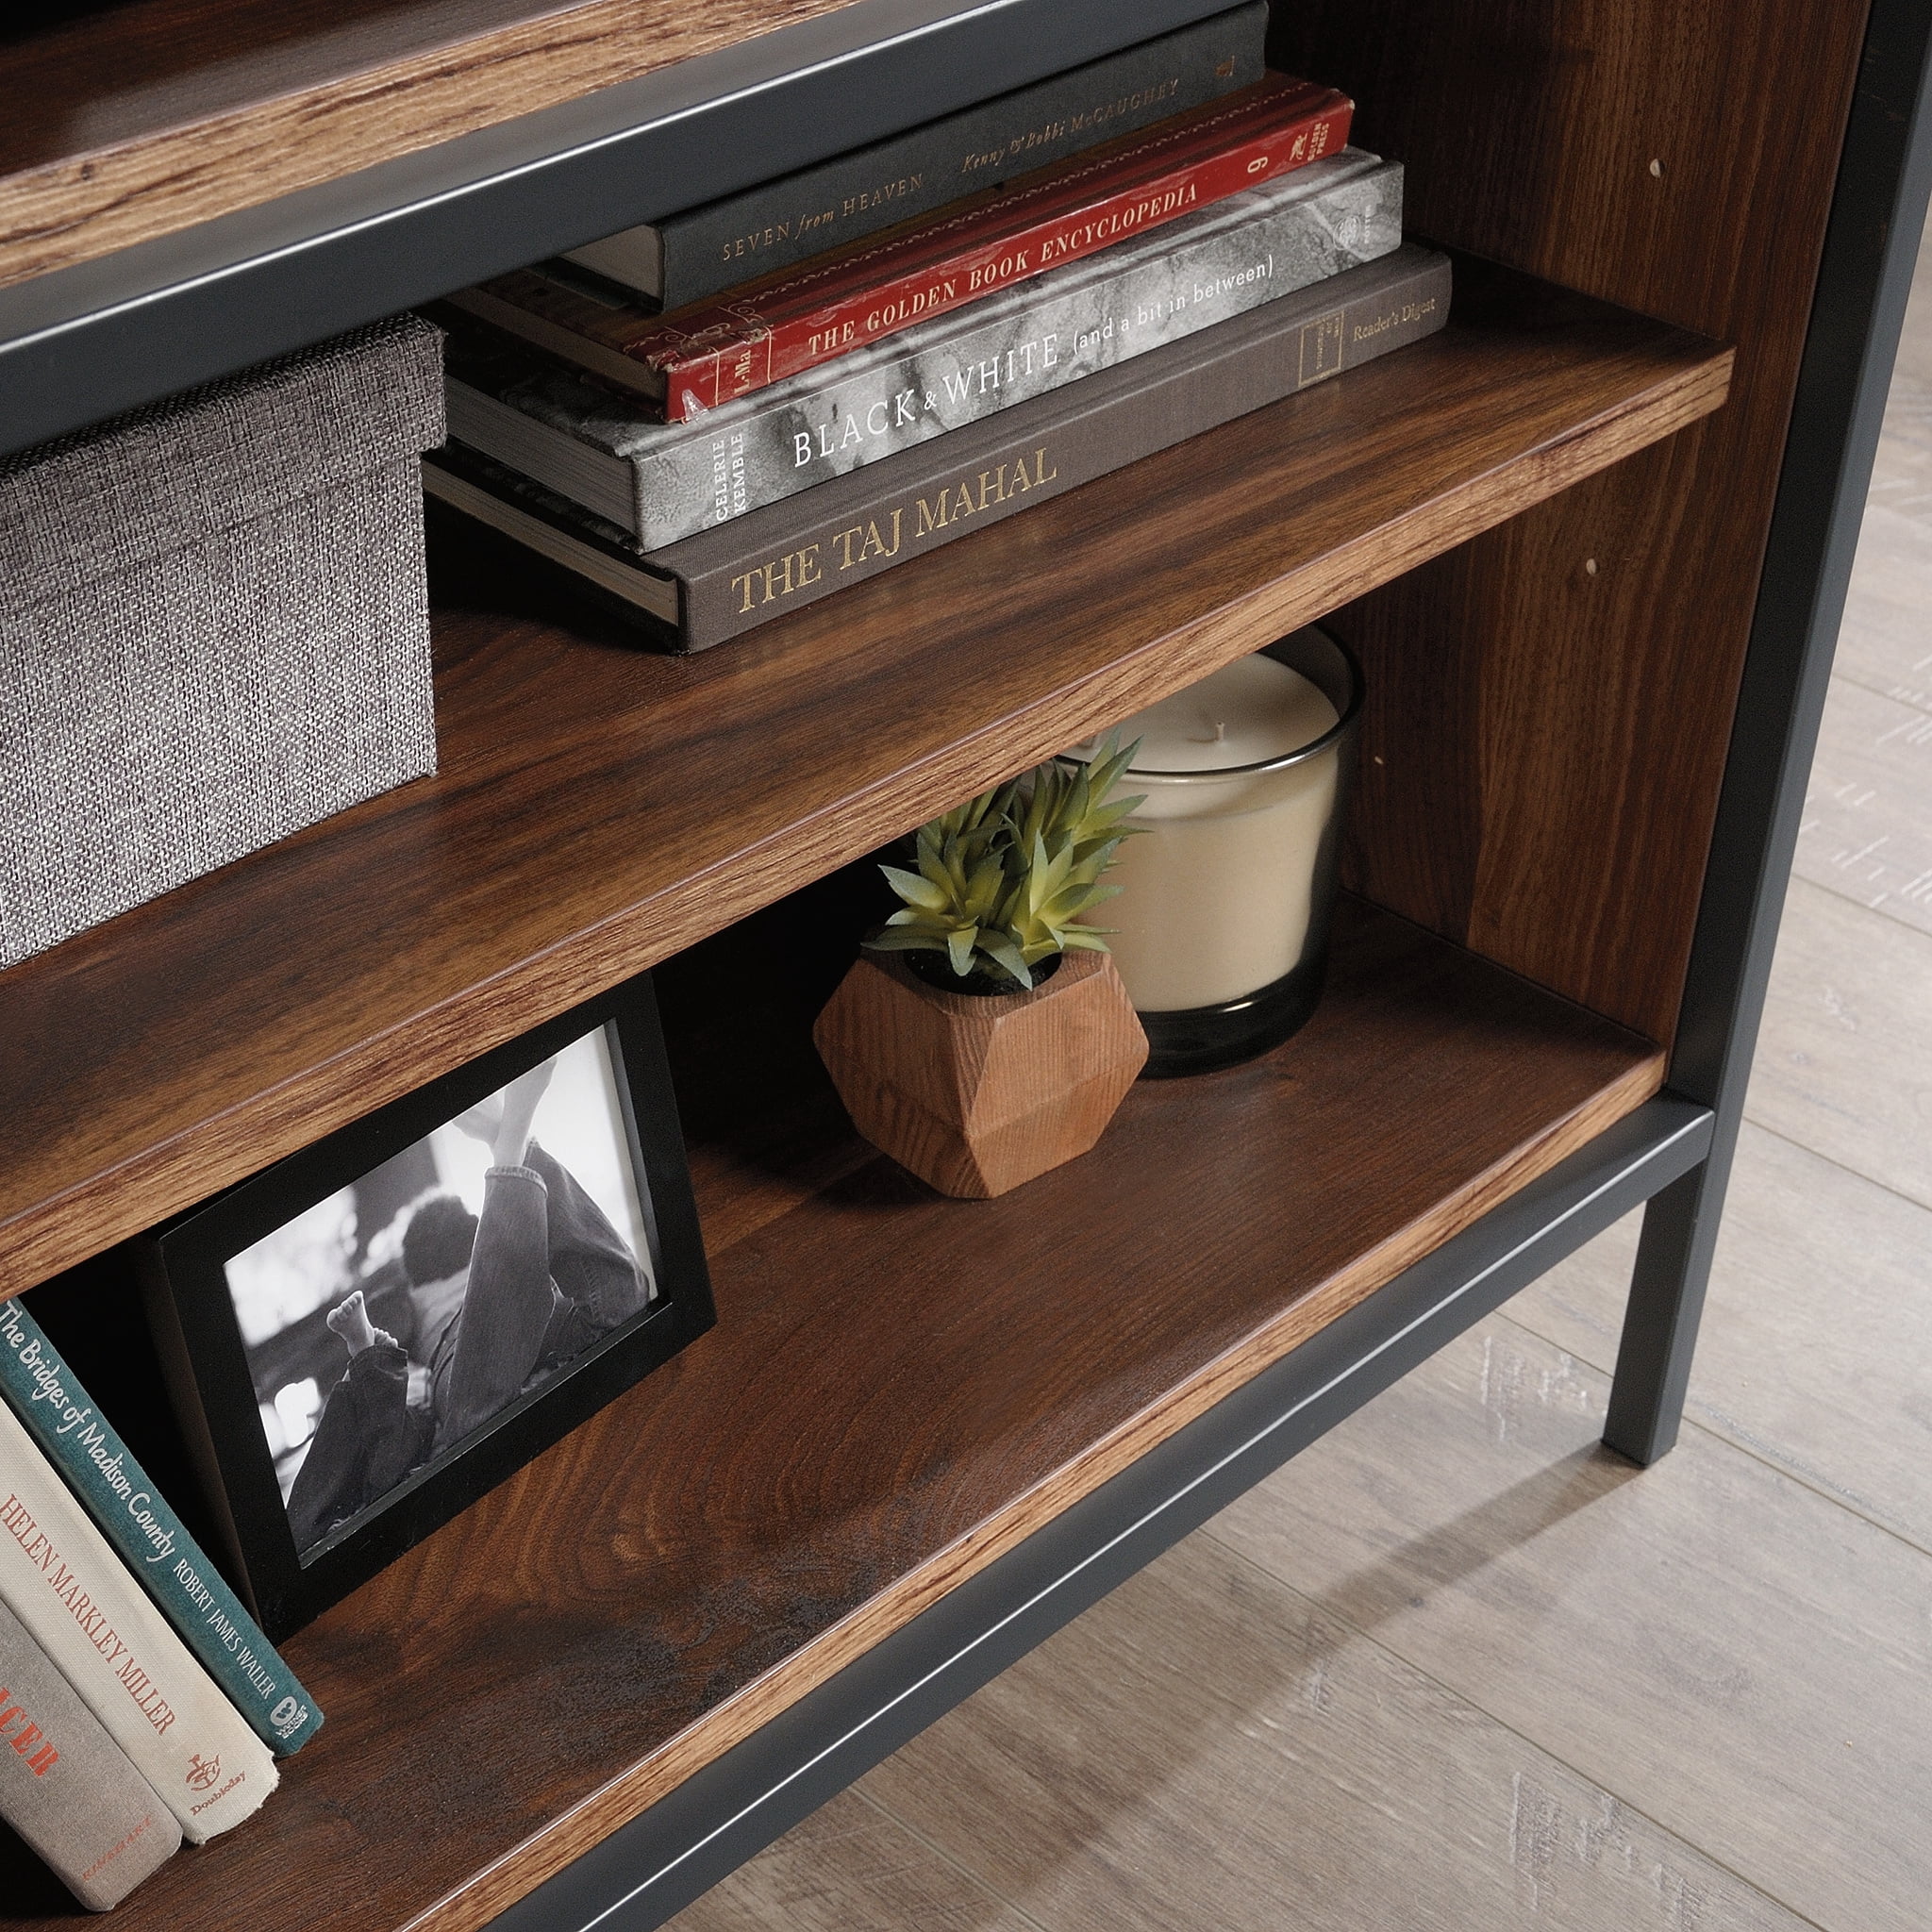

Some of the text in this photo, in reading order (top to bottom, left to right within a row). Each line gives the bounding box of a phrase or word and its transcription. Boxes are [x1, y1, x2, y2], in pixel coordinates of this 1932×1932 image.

[961, 79, 1178, 173] Kenny & Bobbi McCAUGHEY
[1247, 157, 1268, 174] 9
[1307, 123, 1322, 161] GOLDEN
[724, 174, 924, 261] SEVEN from HEAVEN
[808, 183, 1197, 356] THE GOLDEN BOOK ENCYCLOPEDIA
[1401, 298, 1436, 323] Digest
[793, 255, 1273, 468] BLACK & WHITE (and a bit in between)
[713, 440, 727, 521] CELERIE
[731, 434, 746, 513] KEMBLE
[731, 448, 1058, 613] THE TAJ MAHAL
[0, 1300, 175, 1564] The Bridges of Madison County
[0, 1493, 176, 1737] HELEN MARKLEY MILLER
[173, 1557, 277, 1699] ROBERT JAMES WALLER
[190, 1771, 245, 1816] Doubleday
